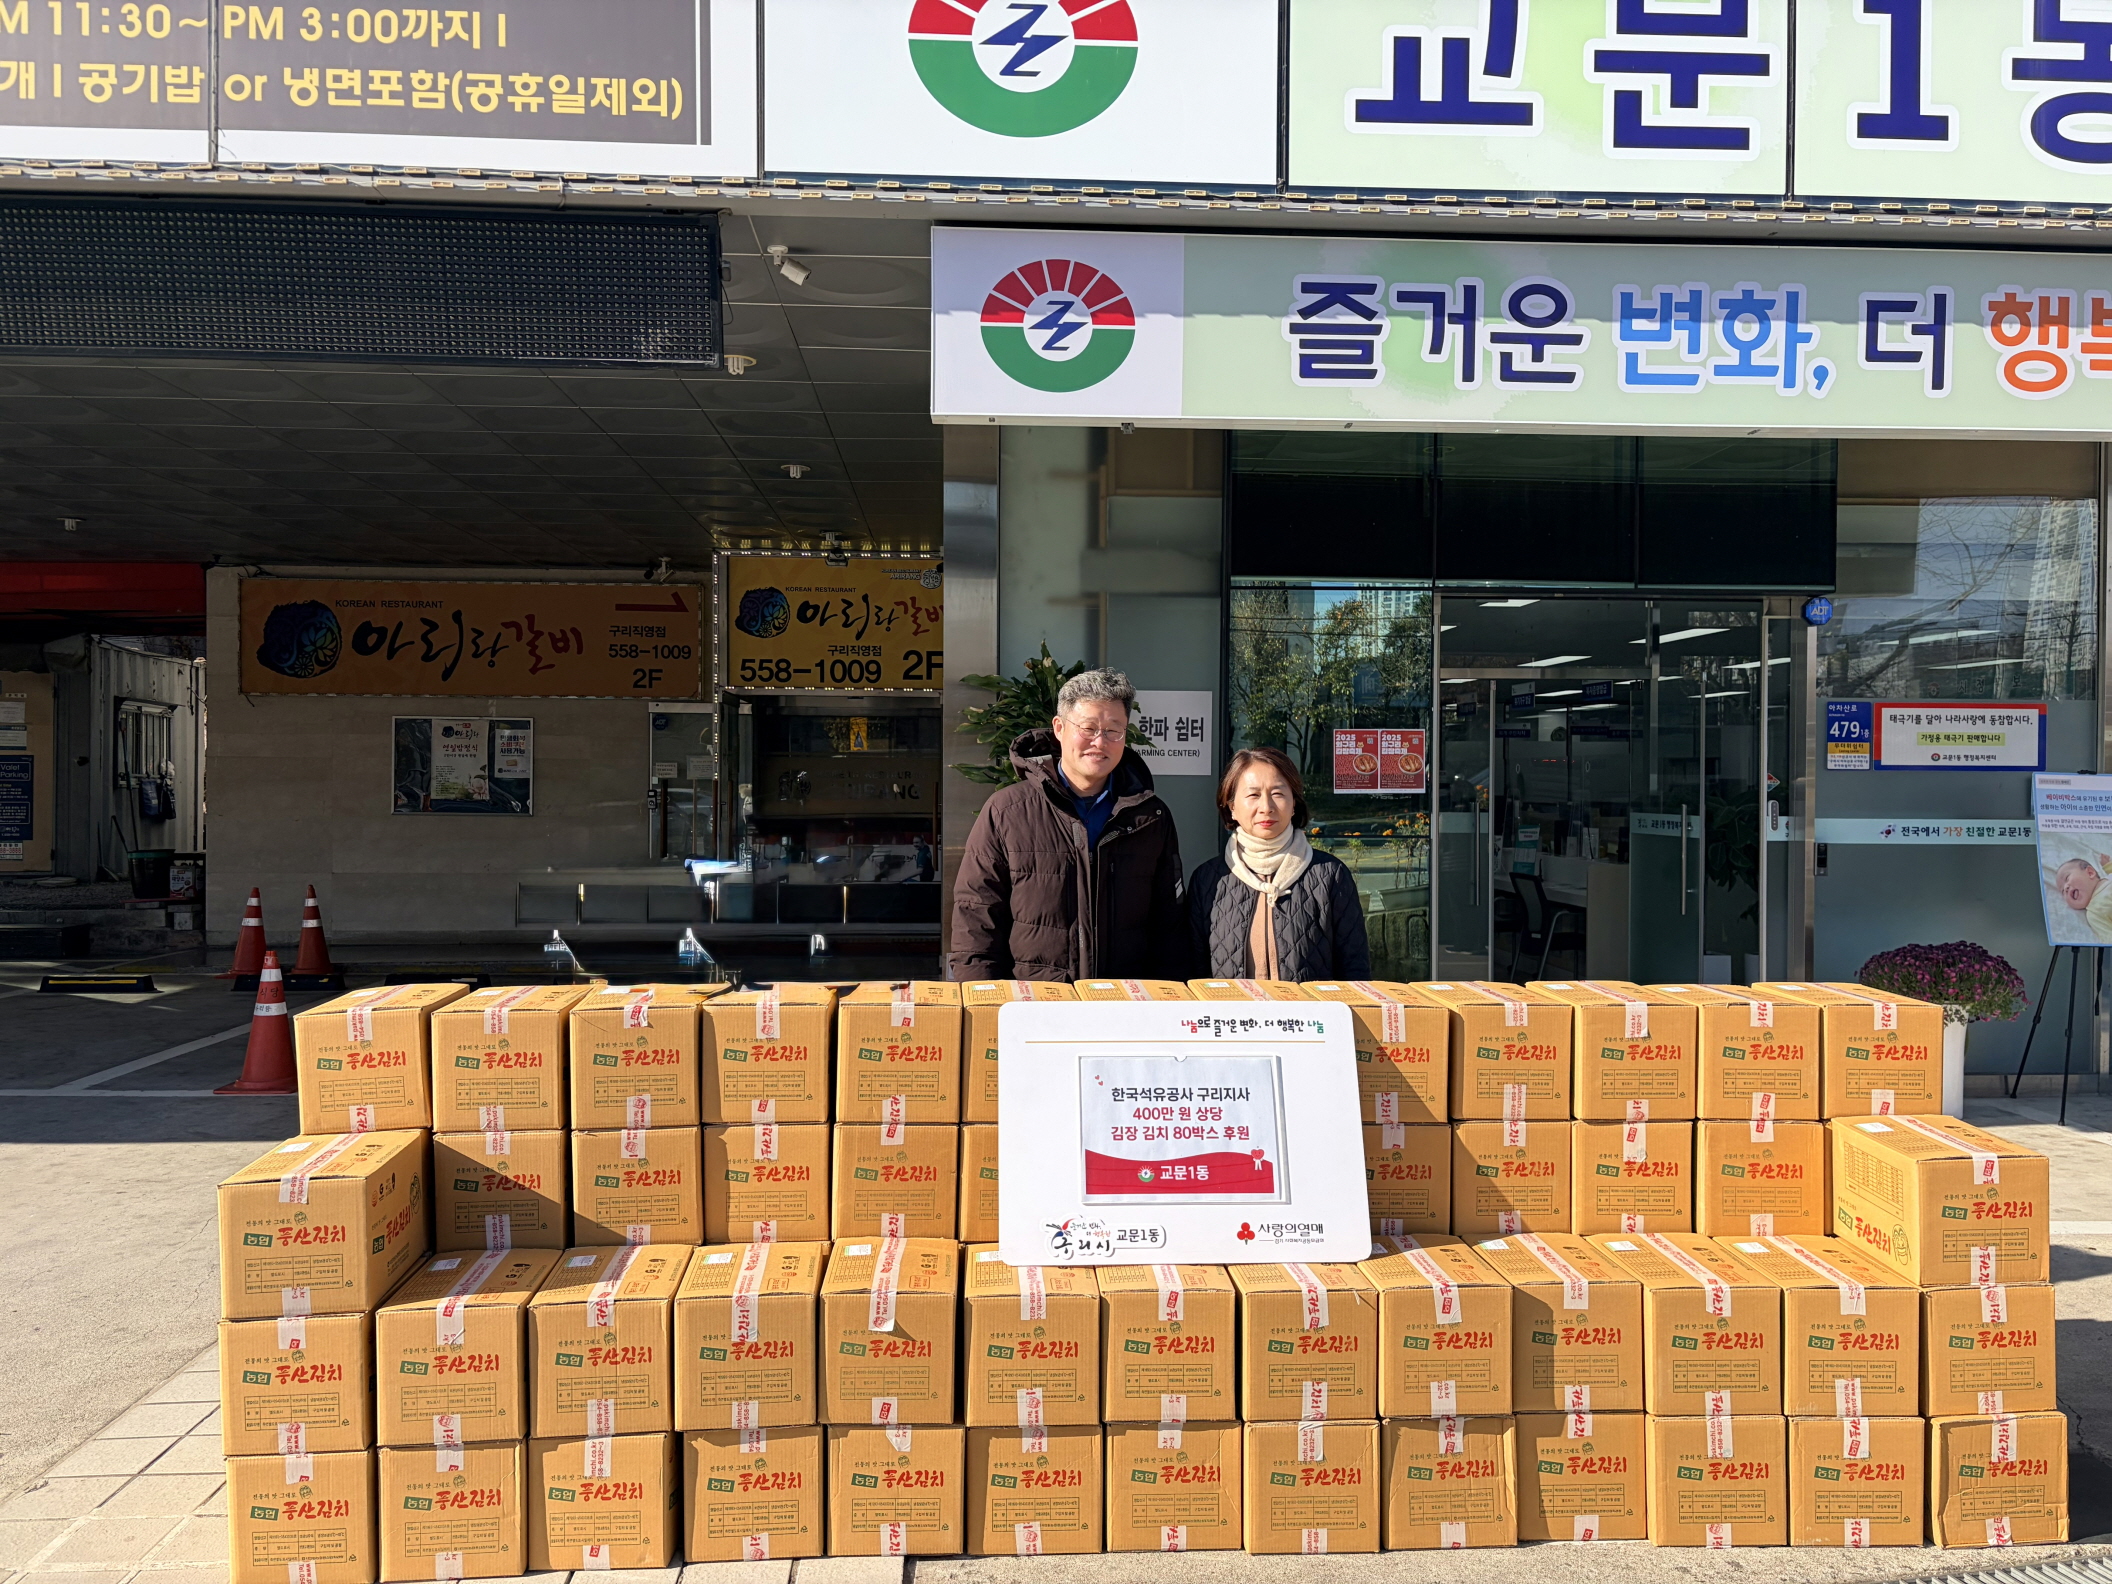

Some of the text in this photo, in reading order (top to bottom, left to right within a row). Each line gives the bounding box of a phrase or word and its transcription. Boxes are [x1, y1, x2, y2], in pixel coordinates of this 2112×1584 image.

[224, 5, 284, 41] PM
[299, 9, 480, 49] 3:00까지
[79, 63, 205, 103] 공기밥
[224, 73, 267, 101] or
[283, 67, 683, 120] 냉면포함(공휴일제외)
[1287, 281, 1584, 387] 즐거운
[1618, 287, 1830, 391] 변화,
[1864, 293, 1947, 391] 더
[786, 586, 858, 594] KOREAN RESTAURANT
[335, 599, 444, 609] KOREAN RESTAURANT
[1810, 606, 1829, 616] ADT
[608, 625, 667, 639] 구리직영점
[607, 643, 693, 660] 558-1009
[827, 645, 883, 657] 구리직영점
[739, 657, 882, 685] 558-1009
[902, 649, 943, 682] 2F
[632, 668, 664, 689] 2F
[1828, 704, 1858, 713] 아차산로
[1889, 713, 2034, 726] 태극기를 달아 나라사랑에 동참합시다.
[1138, 715, 1204, 743] 한파 쉼터
[1829, 721, 1860, 738] 479
[1921, 733, 2002, 744] 가정용 태극기 판매합니다
[1134, 749, 1201, 758] ARMING CENTER)
[1963, 754, 1997, 763] 행정복지센터
[1, 772, 29, 780] Parking
[1900, 826, 2032, 838] 전국에서 가장 친절한 교문1동
[1181, 1016, 1211, 1034] 나눔으로
[1213, 1018, 1238, 1037] 즐거운
[1264, 1019, 1274, 1027] 더
[1276, 1018, 1305, 1034] 행복한
[1307, 1019, 1325, 1034] 나눔
[320, 1051, 407, 1070] 농협 풍산김치
[485, 1052, 543, 1069] 풍산김치
[623, 1049, 680, 1067] 풍산김치
[752, 1045, 808, 1062] 풍산김치
[888, 1045, 943, 1062] 풍산김치
[1376, 1046, 1430, 1063] 풍산김치
[1480, 1044, 1557, 1061] 농협 풍산김치
[1629, 1044, 1681, 1061] 풍산김치
[1751, 1043, 1803, 1060] 풍산김치
[1849, 1044, 1928, 1061] 농협 풍산김치
[1111, 1087, 1251, 1102] 한국석유공사 구리지사
[1132, 1106, 1223, 1122] 400만 원 상당
[1110, 1126, 1250, 1141] 김장 김치 80박스 후원
[755, 1166, 810, 1182] 풍산김치
[882, 1165, 937, 1182] 풍산김치
[1159, 1165, 1210, 1181] 교문1동
[1378, 1163, 1433, 1181] 풍산김치
[1501, 1160, 1556, 1179] 풍산김치
[1624, 1159, 1679, 1178] 풍산김치
[1749, 1163, 1803, 1179] 풍산김치
[483, 1174, 541, 1193] 풍산김치
[624, 1170, 681, 1188] 풍산김치
[1973, 1201, 2033, 1220] 풍산김치
[385, 1204, 411, 1245] 풍산김치
[1257, 1222, 1324, 1238] 사랑의열매
[278, 1226, 346, 1246] 풍산김치
[1116, 1229, 1160, 1243] 교문1동
[1854, 1216, 1891, 1255] 풍산김치
[1053, 1236, 1110, 1254] 구리시
[1155, 1336, 1215, 1354] 풍산김치
[1299, 1335, 1359, 1354] 풍산김치
[1434, 1332, 1493, 1350] 풍산김치
[1562, 1327, 1621, 1345] 풍산김치
[1704, 1332, 1764, 1350] 풍산김치
[1840, 1332, 1899, 1351] 풍산김치
[1979, 1331, 2037, 1349] 풍산김치
[589, 1346, 652, 1367] 풍산김치
[870, 1340, 932, 1358] 풍산김치
[1018, 1341, 1079, 1360] 풍산김치
[434, 1354, 500, 1375] 풍산김치
[276, 1364, 343, 1385] 풍산김치
[1162, 1465, 1221, 1484] 풍산김치
[1437, 1460, 1495, 1480] 풍산김치
[1569, 1456, 1627, 1475] 풍산김치
[1709, 1462, 1769, 1481] 풍산김치
[1846, 1463, 1905, 1481] 풍산김치
[740, 1472, 802, 1492] 풍산김치
[884, 1469, 945, 1489] 풍산김치
[1022, 1470, 1082, 1488] 풍산김치
[1301, 1468, 1361, 1486] 풍산김치
[436, 1489, 501, 1511] 풍산김치
[581, 1482, 643, 1502] 풍산김치
[284, 1500, 349, 1521] 풍산김치
